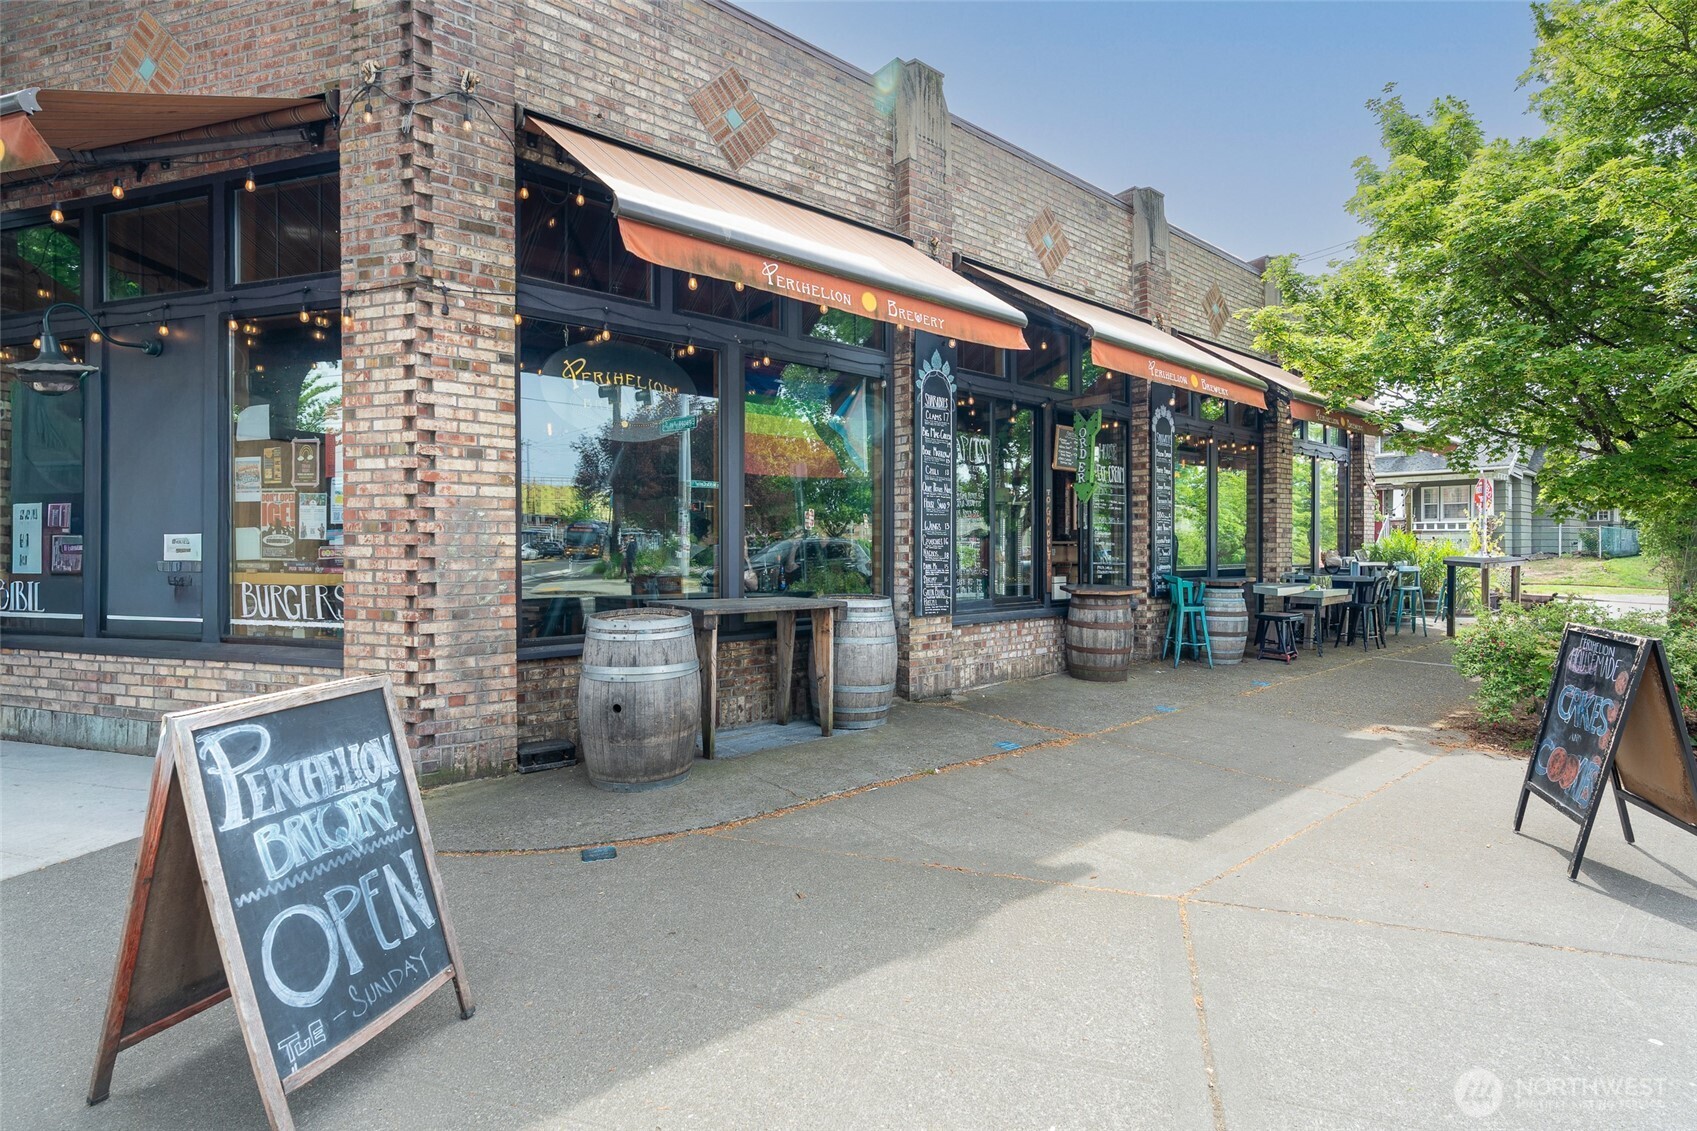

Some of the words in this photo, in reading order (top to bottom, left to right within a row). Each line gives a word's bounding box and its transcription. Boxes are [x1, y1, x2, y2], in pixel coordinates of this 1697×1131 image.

[762, 262, 851, 306] PERIHELION
[888, 300, 944, 329] BREWERY
[562, 358, 675, 399] PERIHELION
[1148, 360, 1188, 385] PERIHELION
[1201, 378, 1228, 396] BREWERY
[1077, 427, 1088, 484] ORDER
[262, 502, 295, 527] ICE!
[1557, 684, 1615, 737] CAKES
[261, 849, 437, 1008] OPEN
[277, 1019, 327, 1064] TUE
[349, 947, 429, 1019] SUNDAY
